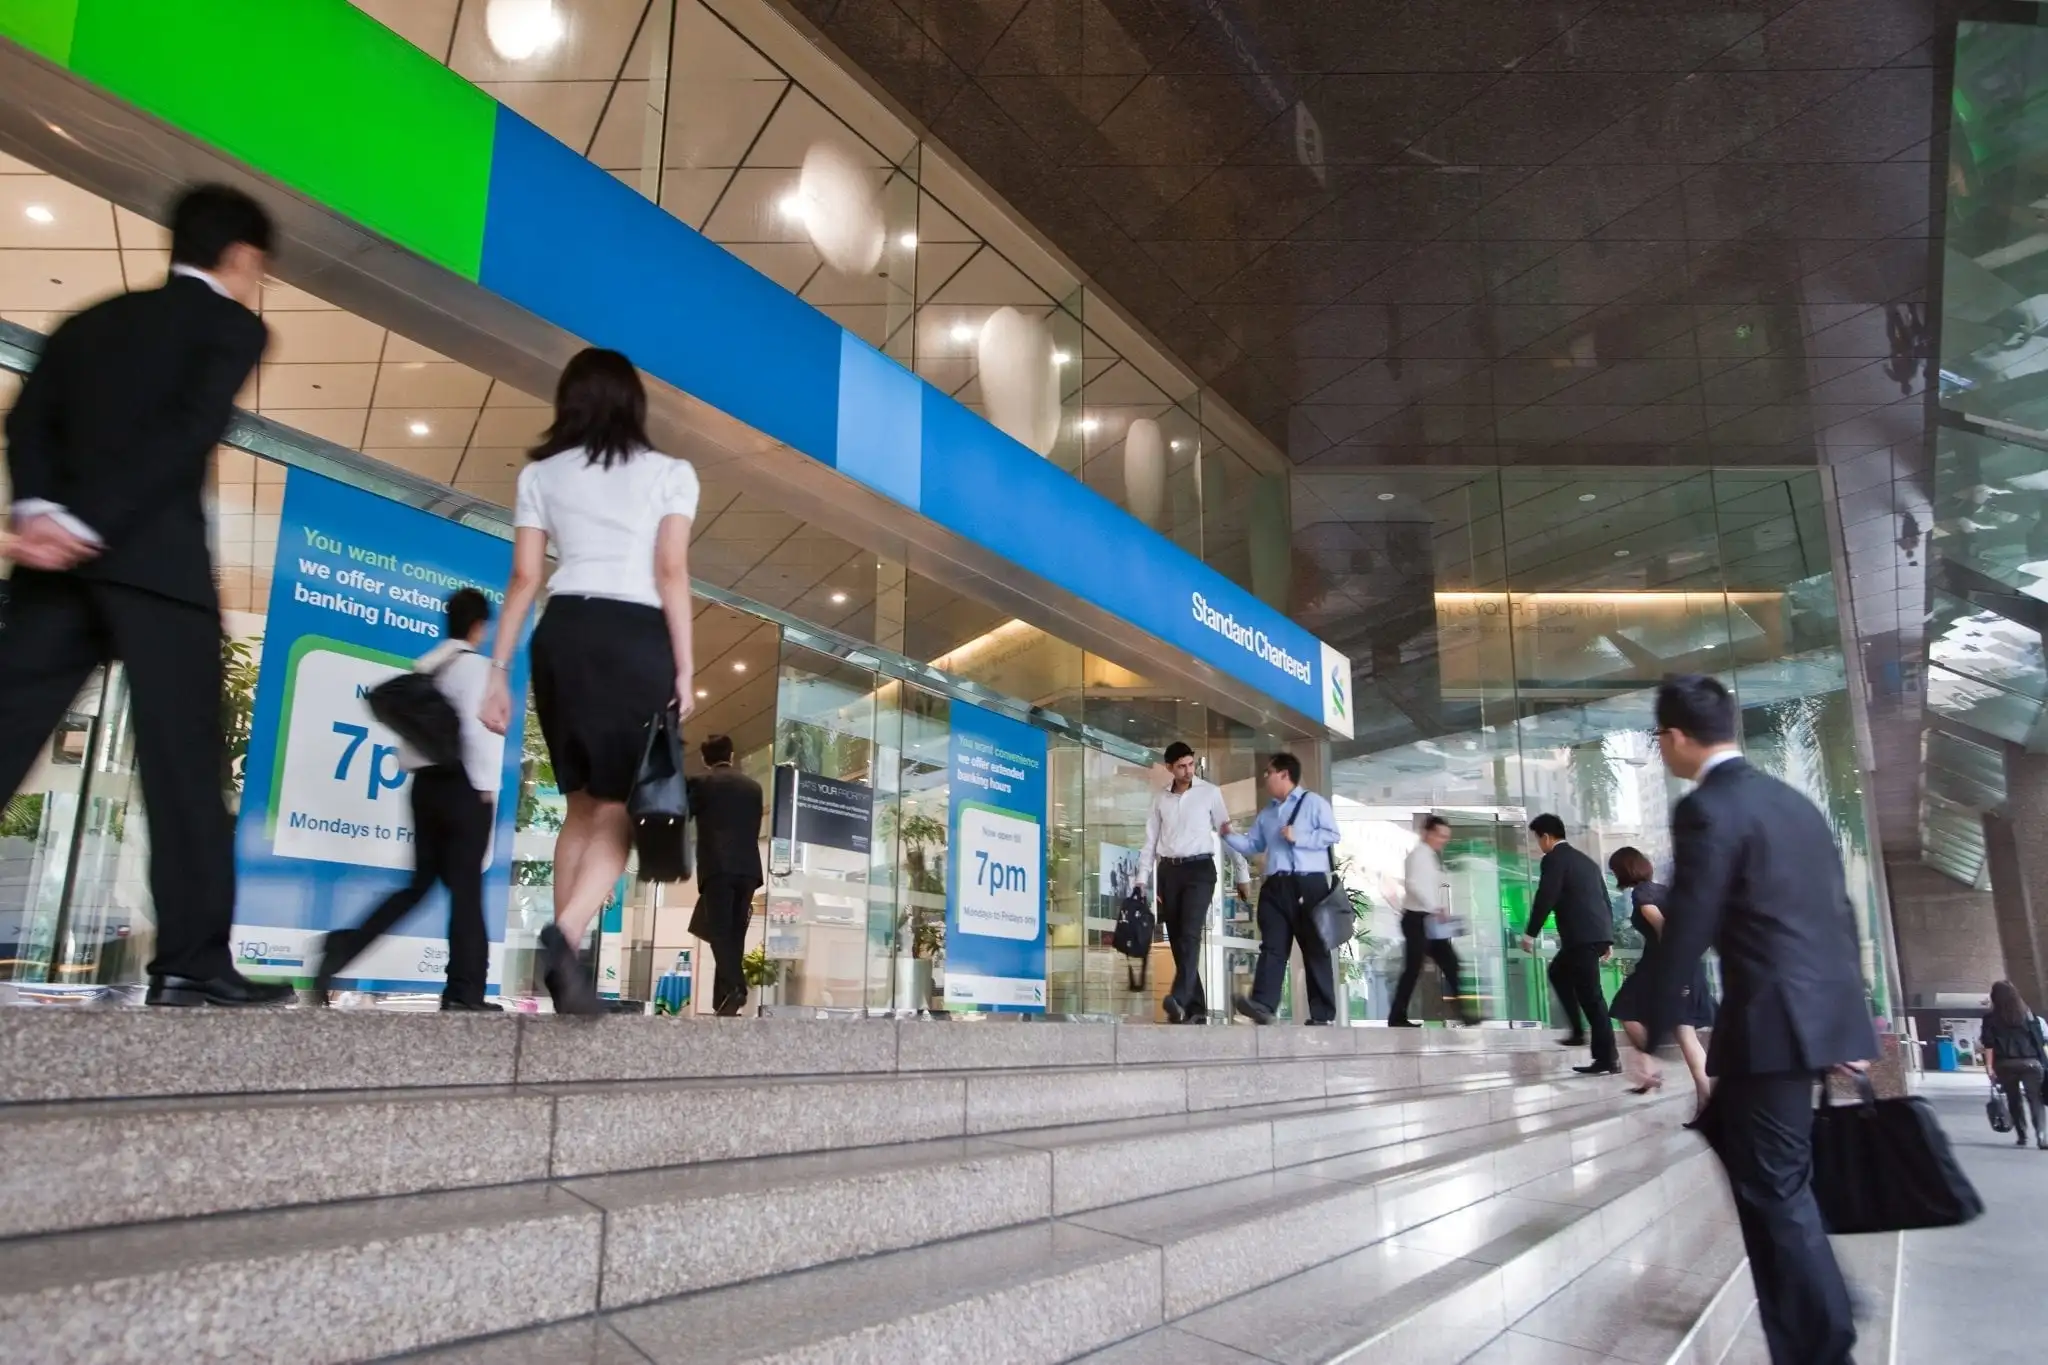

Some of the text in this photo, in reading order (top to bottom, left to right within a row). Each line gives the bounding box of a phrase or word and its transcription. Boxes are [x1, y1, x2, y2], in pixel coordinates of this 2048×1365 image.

[303, 525, 342, 556] You
[348, 544, 398, 572] want
[299, 557, 331, 580] we
[335, 569, 384, 596] offer
[294, 582, 440, 638] banking hours
[1192, 591, 1312, 686] Standard Chartered
[971, 756, 989, 771] offer
[991, 763, 1025, 781] extended
[994, 748, 1039, 769] convenience
[818, 783, 837, 797] YOUR
[957, 768, 1012, 794] banking hours
[290, 811, 370, 840] Mondays
[374, 824, 391, 841] to
[975, 850, 1026, 896] 7pm
[237, 941, 268, 960] 150
